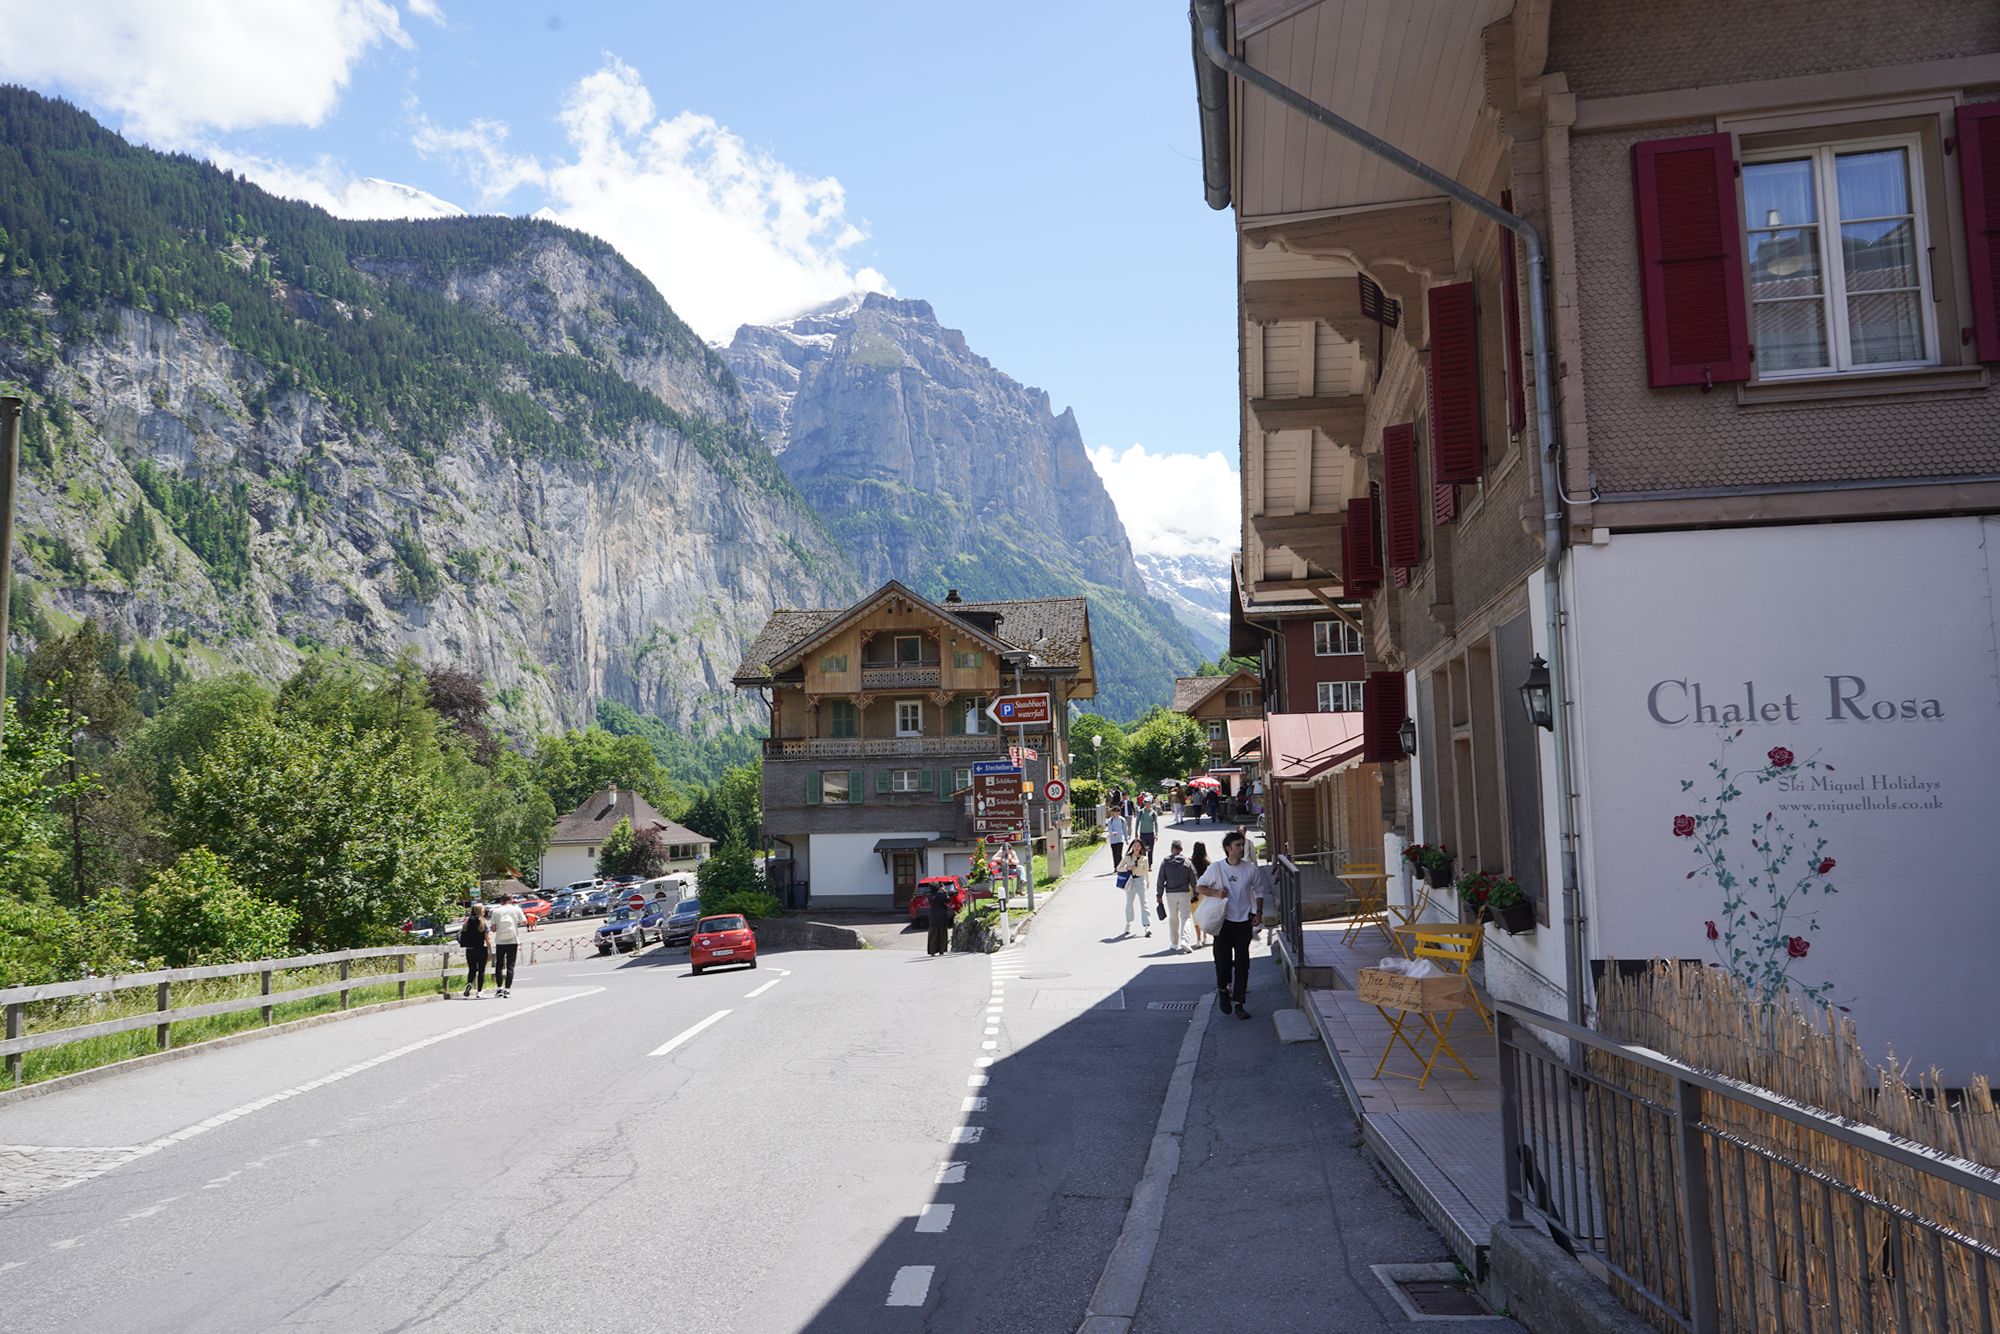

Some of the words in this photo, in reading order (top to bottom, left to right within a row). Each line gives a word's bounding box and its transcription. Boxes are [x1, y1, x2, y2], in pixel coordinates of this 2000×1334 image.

[1014, 700, 1047, 709] Staubbach
[1647, 677, 1800, 725] Chalet
[1823, 675, 1946, 722] Rosa
[1004, 705, 1011, 716] P
[1017, 709, 1045, 719] waterfall
[1051, 787, 1060, 796] 30
[1778, 776, 1805, 792] Ski
[1810, 776, 1866, 795] Miquel
[1871, 774, 1941, 793] Holidays
[1778, 795, 1944, 814] www.miquelhols.co.uk
[1366, 973, 1383, 987] Free
[1385, 975, 1406, 990] Food
